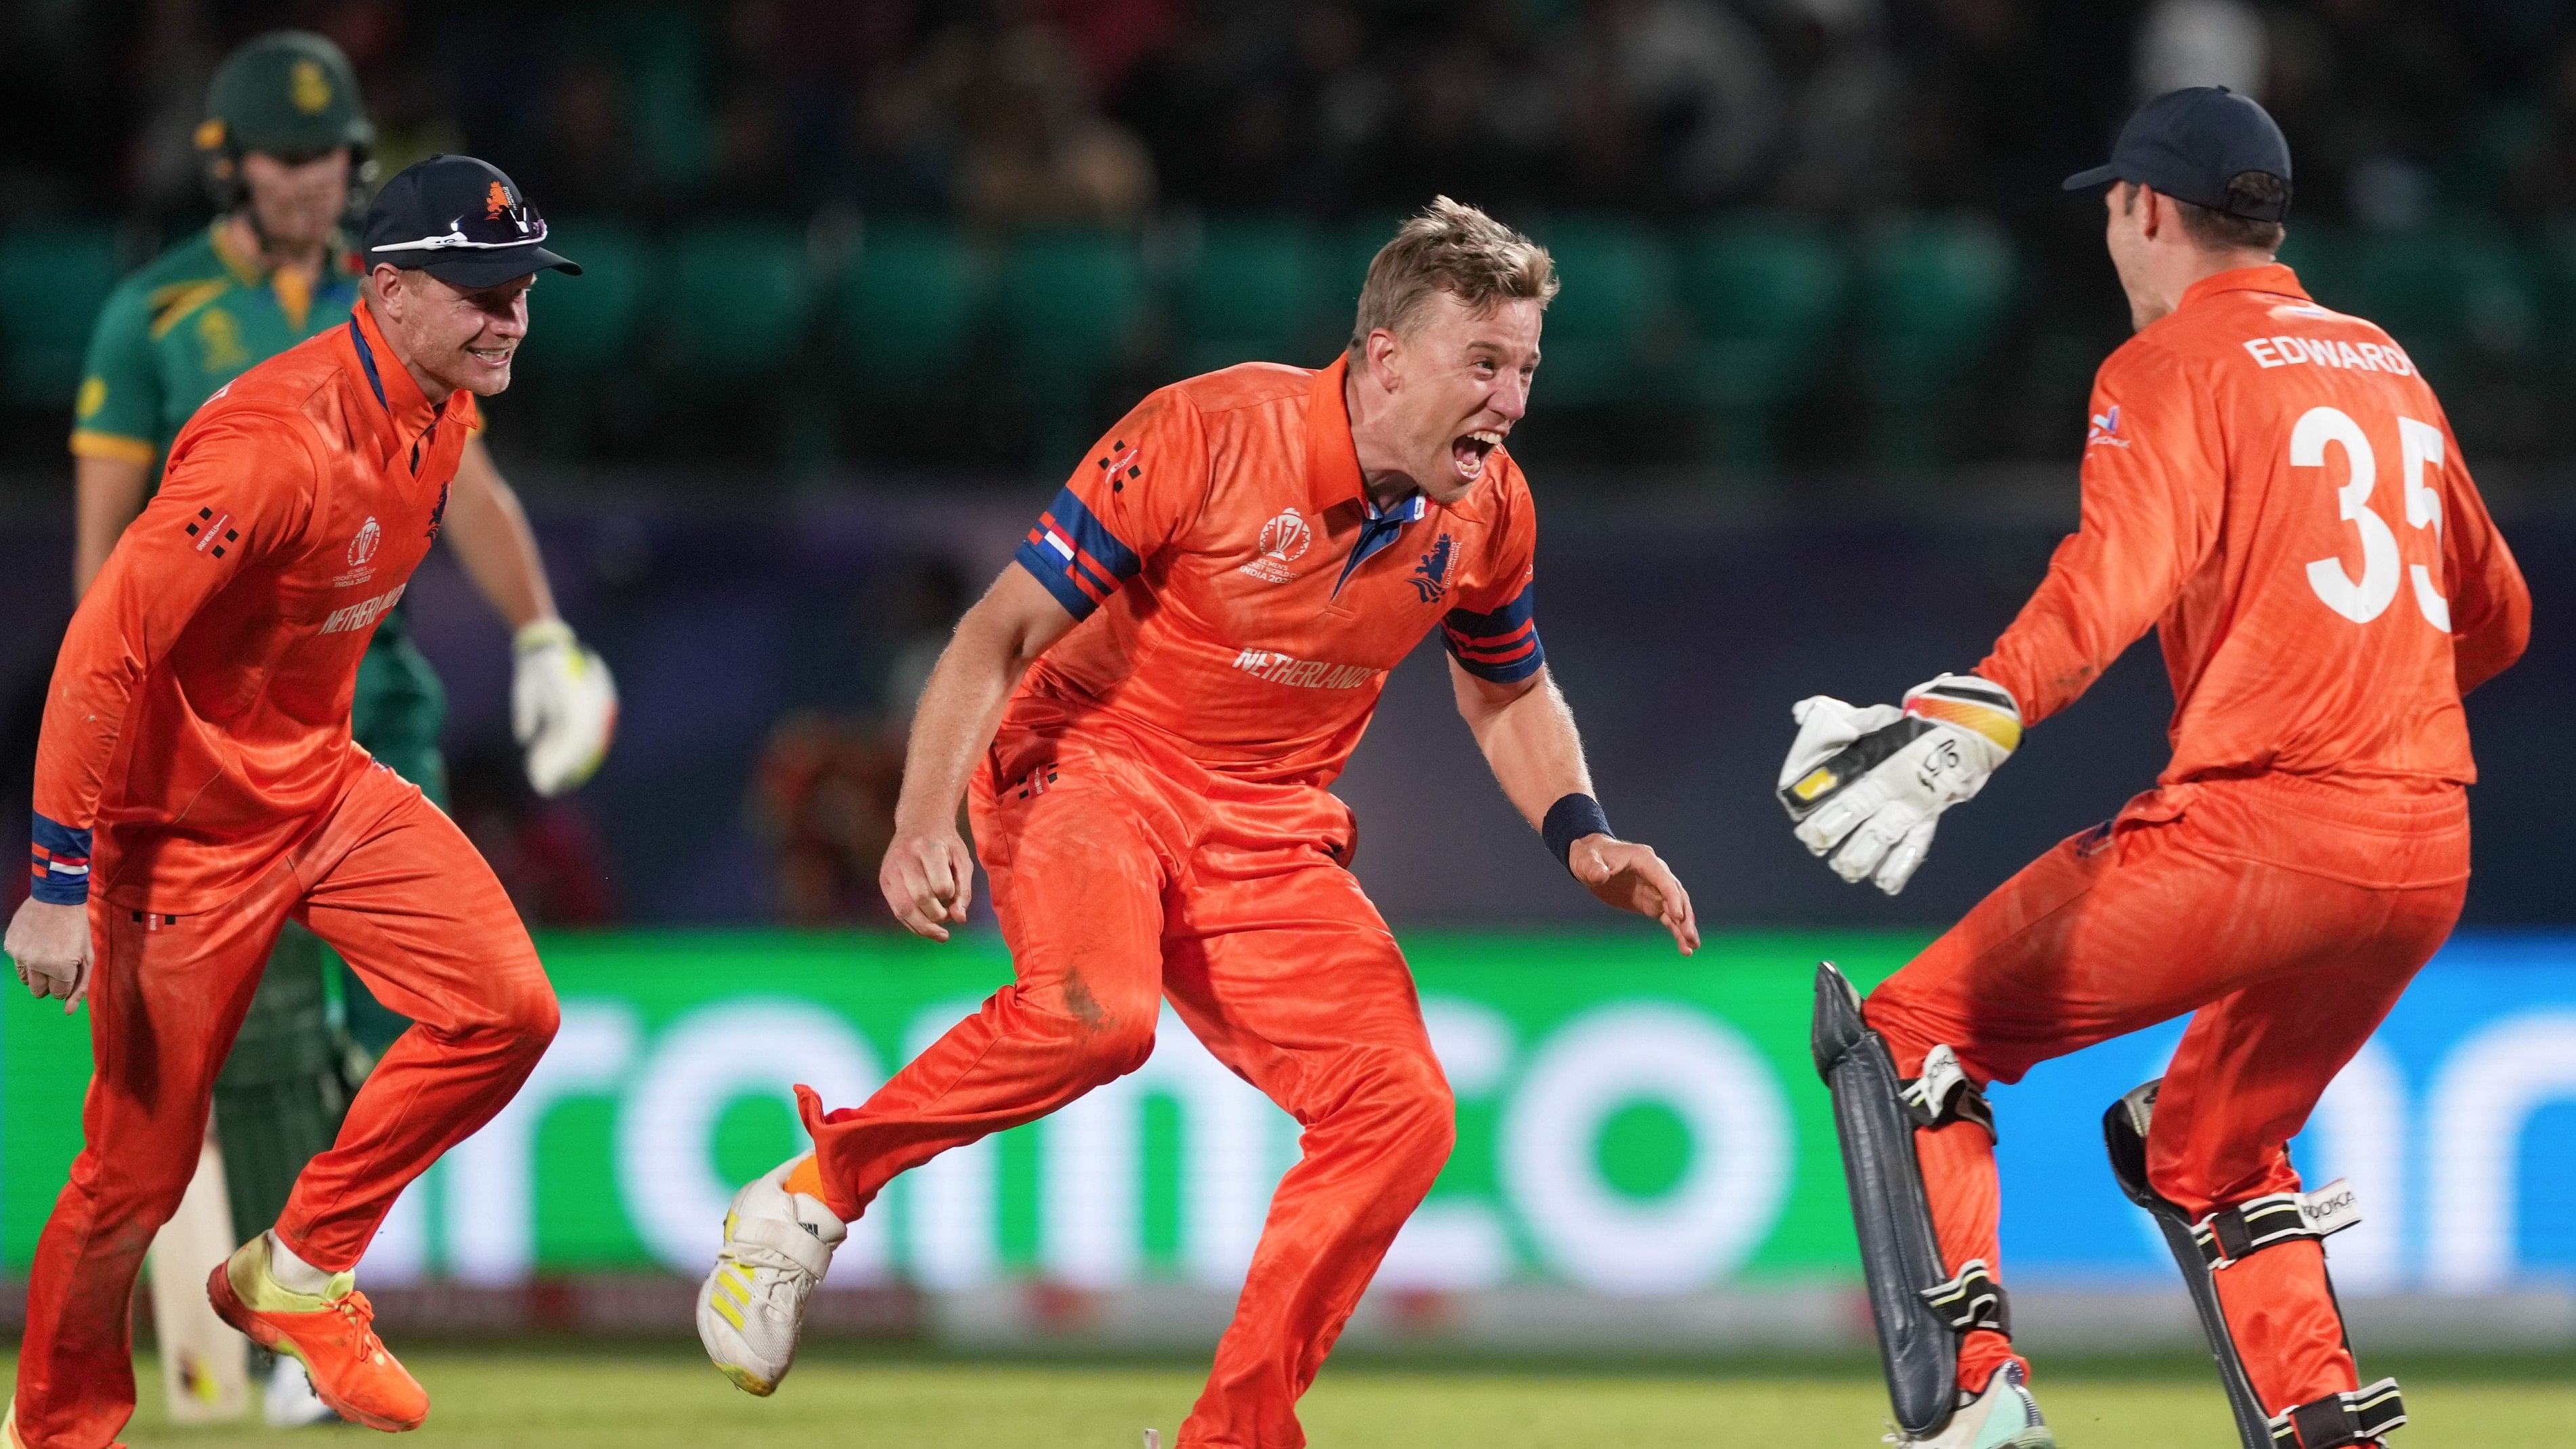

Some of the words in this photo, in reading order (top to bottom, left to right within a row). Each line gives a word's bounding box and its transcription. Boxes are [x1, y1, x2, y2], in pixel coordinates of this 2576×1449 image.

[2243, 335, 2420, 380] EDWARD
[1239, 565, 1268, 580] INDIA
[2290, 406, 2451, 633] 35
[352, 999, 1798, 1297] ramo
